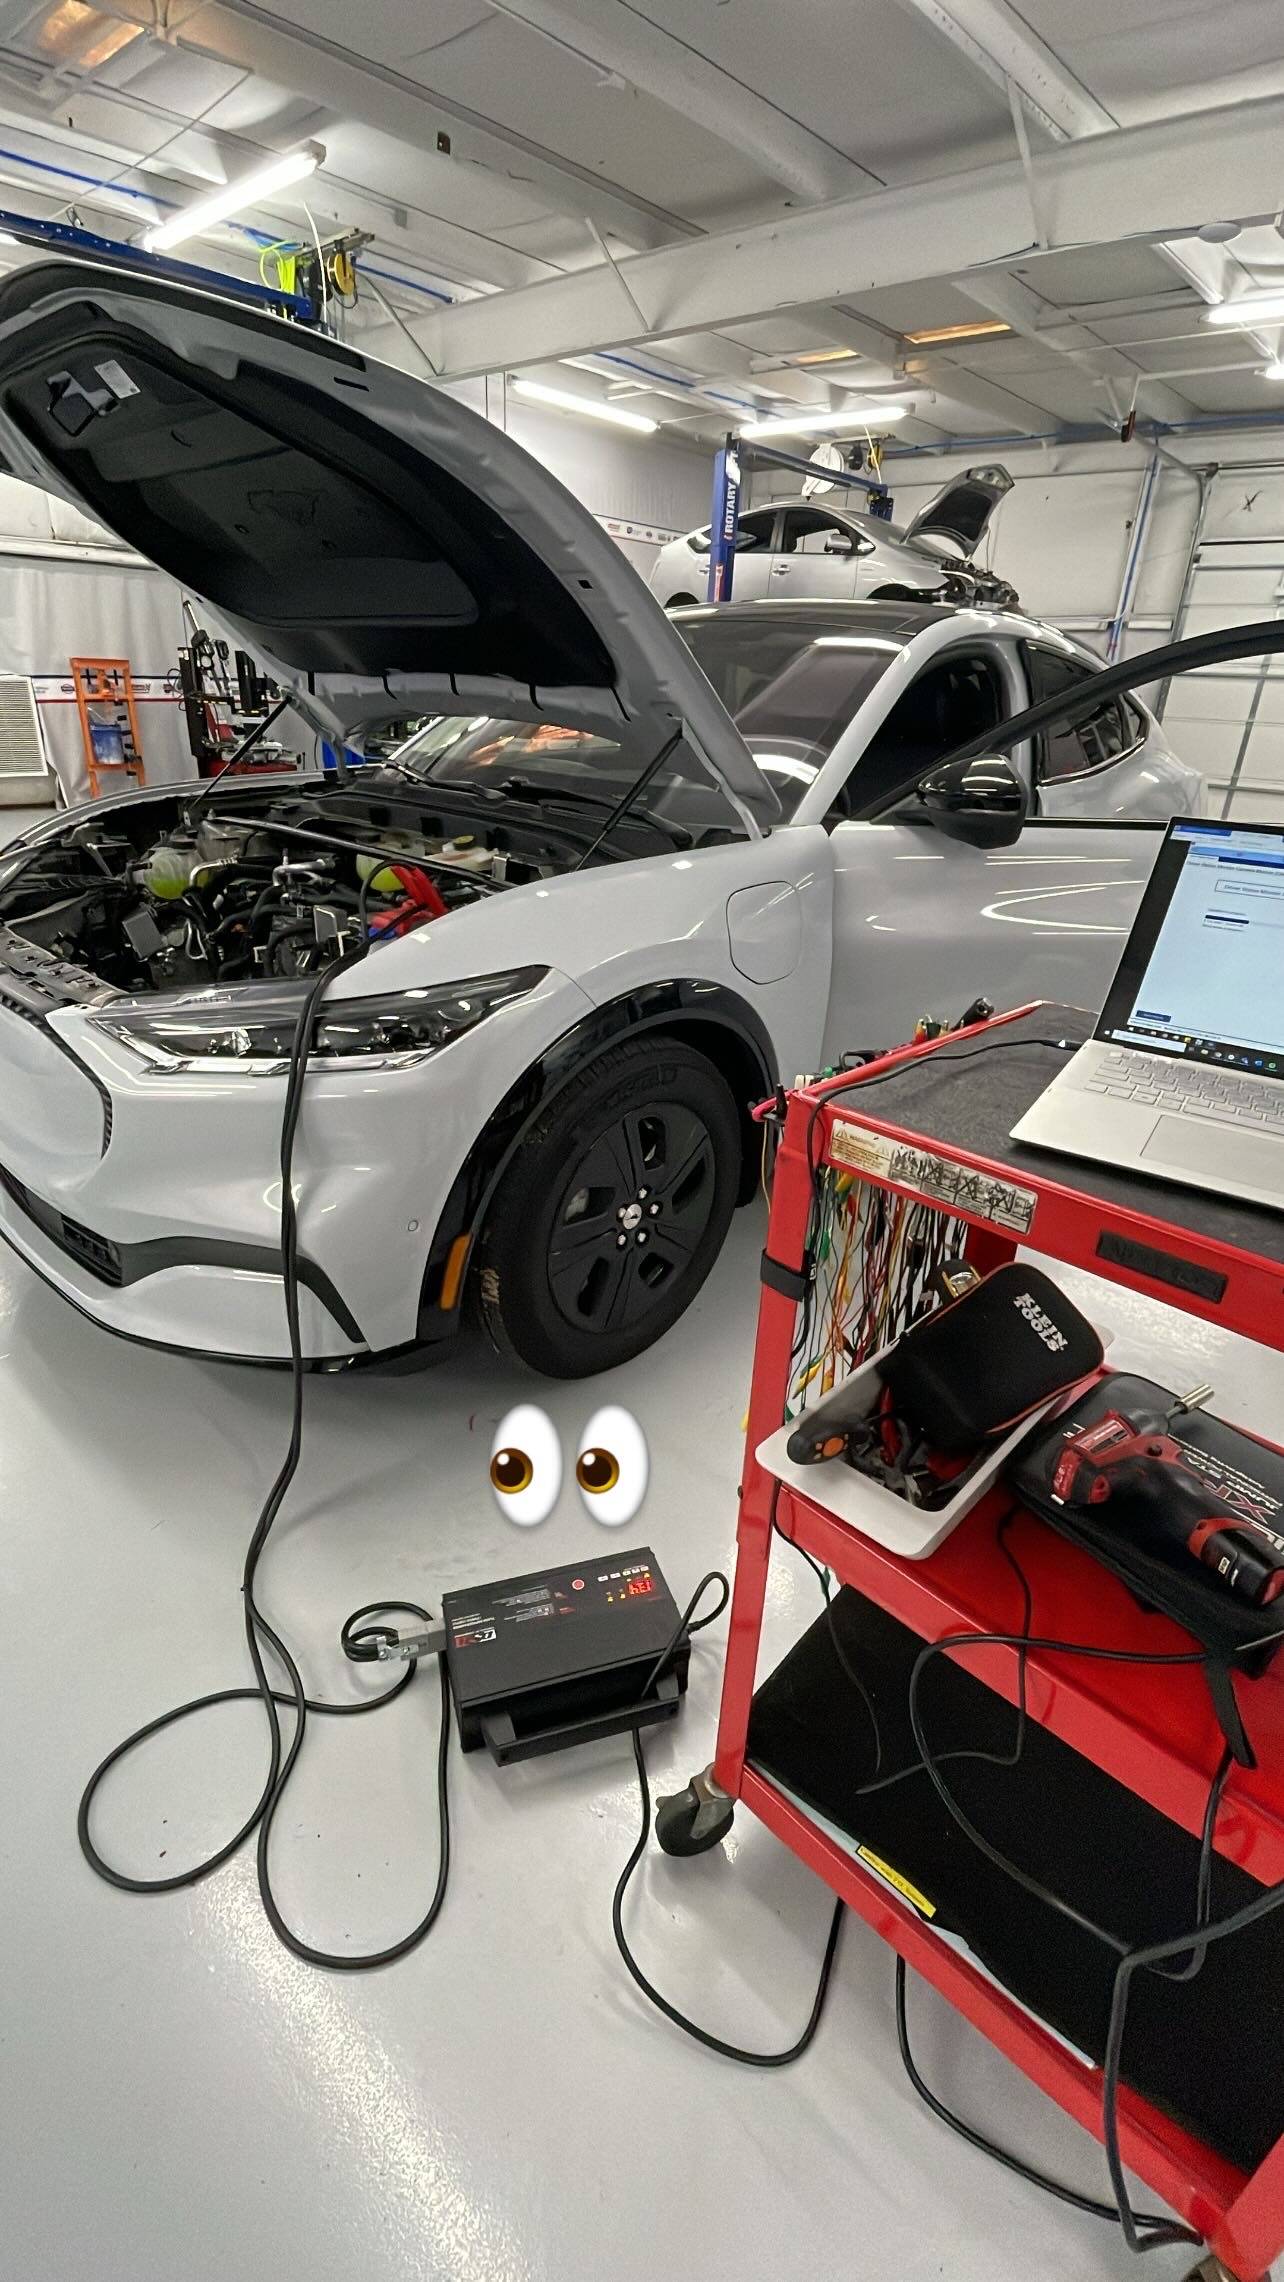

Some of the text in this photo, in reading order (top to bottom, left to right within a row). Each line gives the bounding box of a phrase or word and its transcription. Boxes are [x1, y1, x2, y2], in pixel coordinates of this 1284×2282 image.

[724, 481, 738, 534] ROTARY
[1012, 1300, 1060, 1352] TOOLS
[1015, 1292, 1069, 1346] KLEIN
[1186, 1456, 1222, 1480] STA
